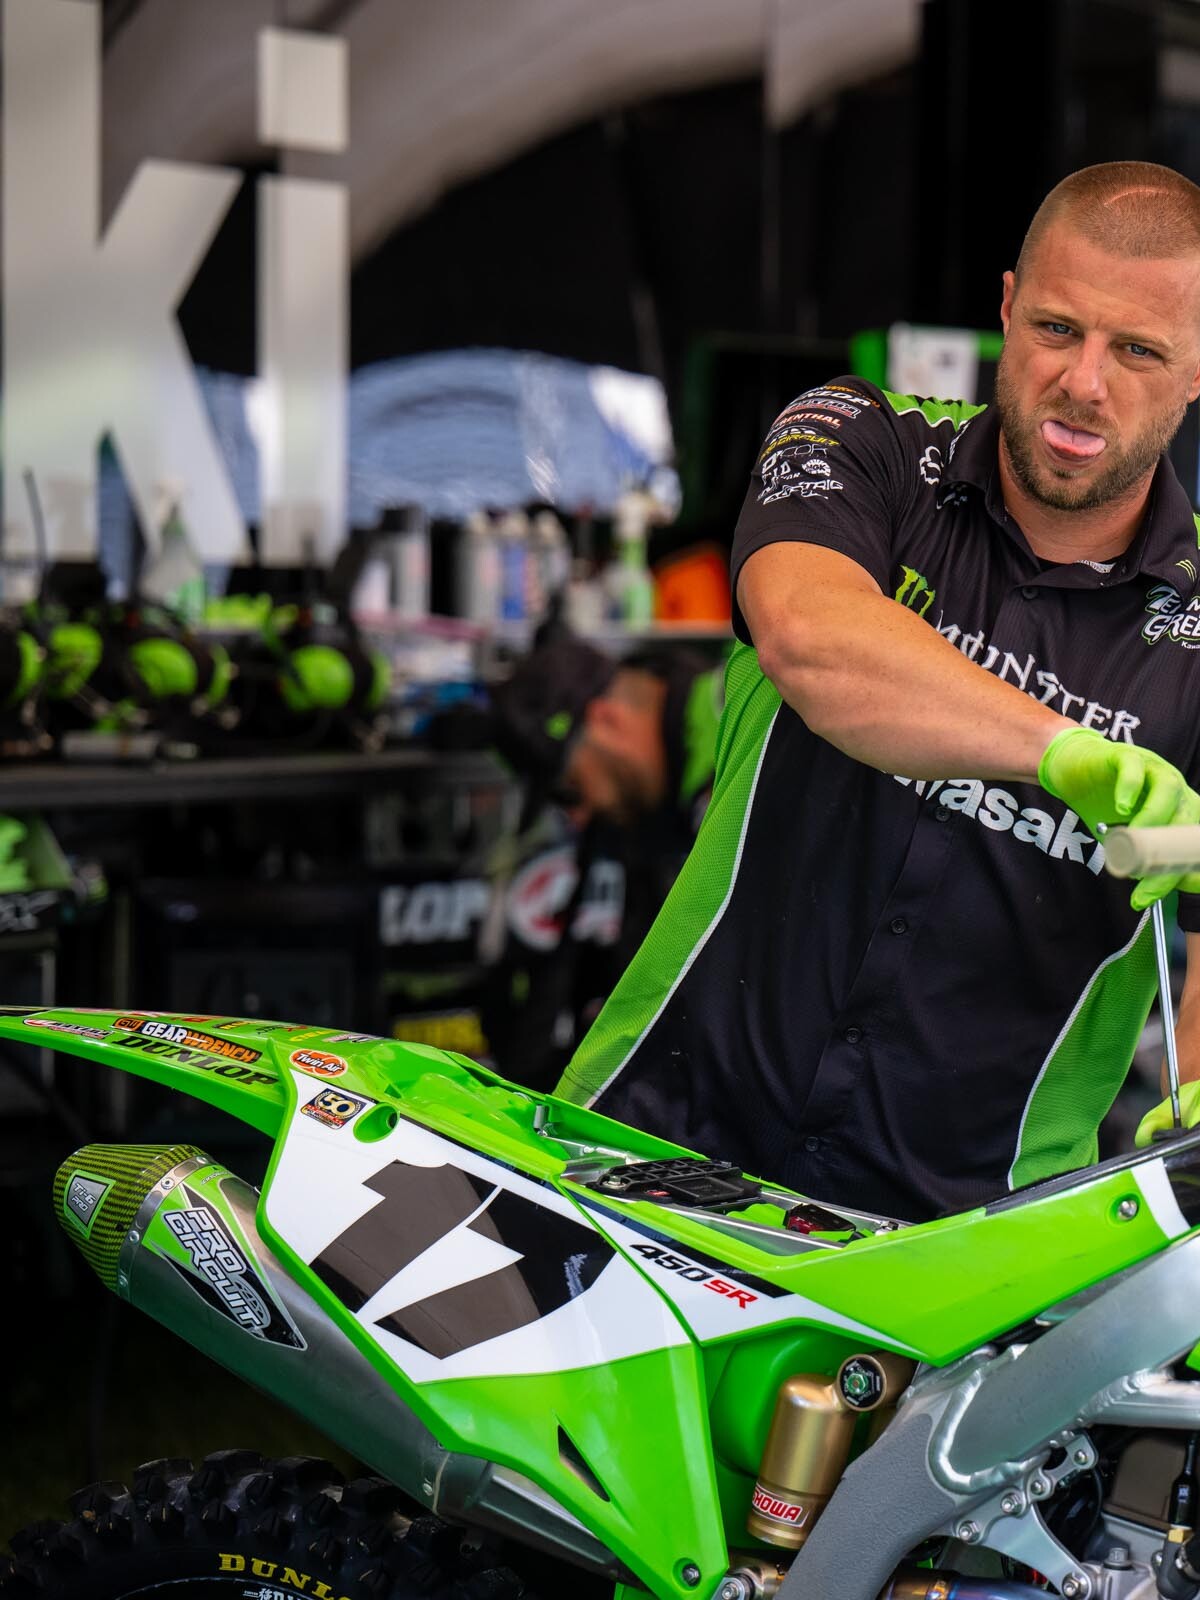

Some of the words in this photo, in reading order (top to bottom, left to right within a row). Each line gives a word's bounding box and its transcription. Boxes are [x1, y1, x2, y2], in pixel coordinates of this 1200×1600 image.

[112, 1036, 279, 1085] DUNLOP
[141, 1021, 257, 1063] GEARWRENCH
[297, 1053, 323, 1067] Twin
[322, 1062, 341, 1072] Air
[320, 1093, 357, 1117] 50
[71, 1196, 89, 1212] PRO
[74, 1183, 97, 1204] Ti-6
[187, 1210, 245, 1274] PRO
[310, 1159, 617, 1360] 11
[164, 1212, 264, 1331] CIRCUIT
